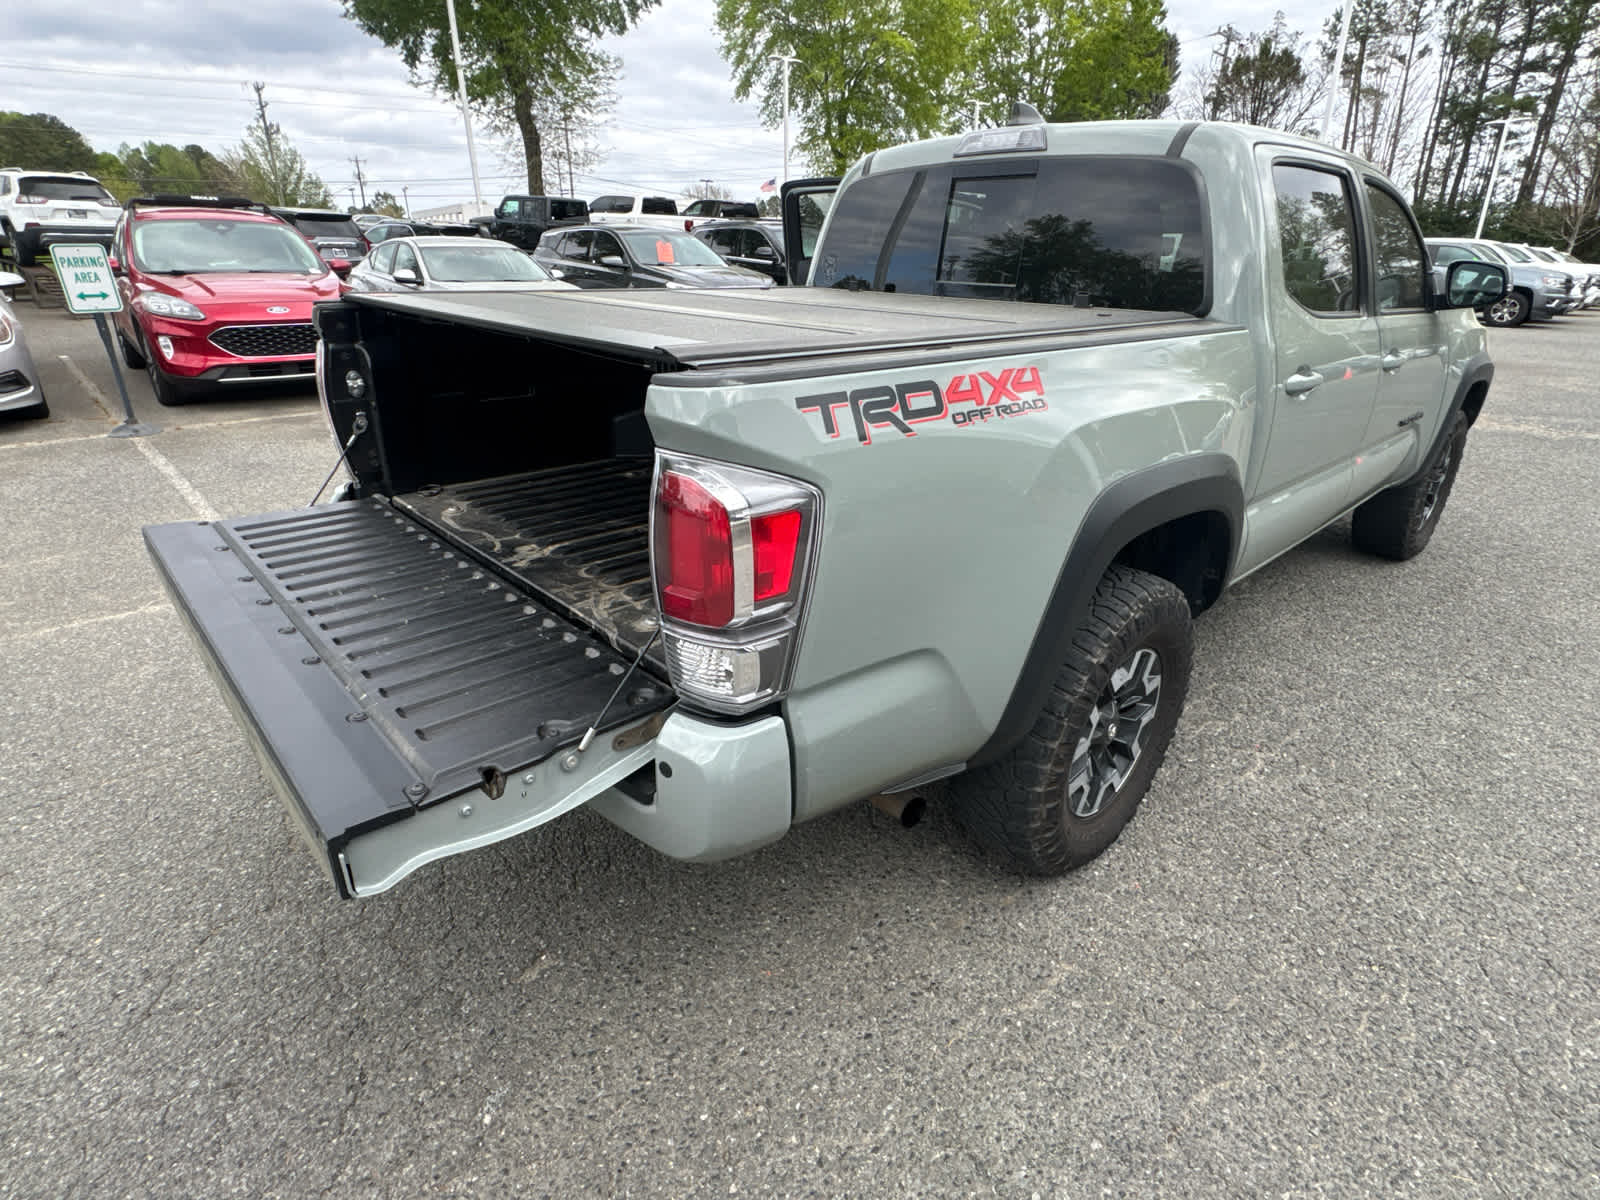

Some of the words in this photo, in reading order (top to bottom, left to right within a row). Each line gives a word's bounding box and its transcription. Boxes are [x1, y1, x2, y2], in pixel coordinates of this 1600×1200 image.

[59, 256, 104, 268] PARKING
[74, 272, 101, 283] AREA
[795, 380, 948, 445] TRD
[952, 407, 993, 427] OFF
[995, 398, 1047, 418] ROAD
